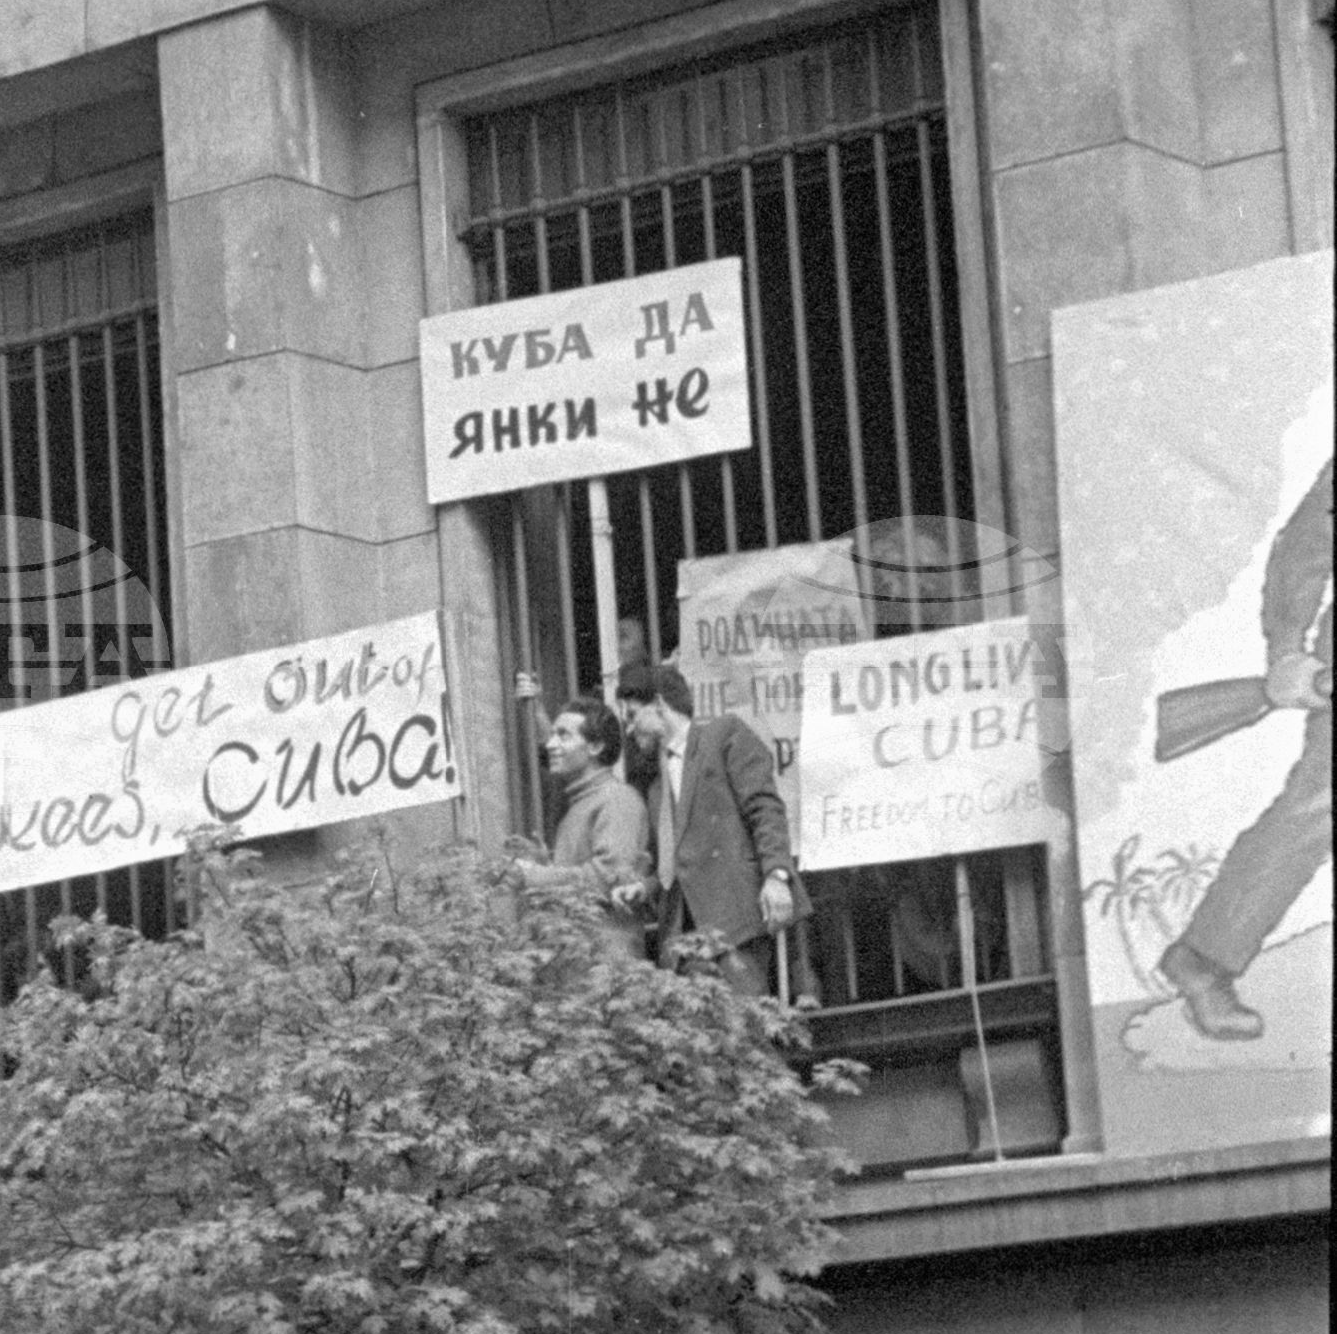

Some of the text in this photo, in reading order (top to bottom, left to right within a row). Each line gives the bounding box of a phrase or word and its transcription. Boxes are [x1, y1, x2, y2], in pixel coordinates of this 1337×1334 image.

[450, 291, 715, 379] КУБА ДА
[448, 397, 598, 459] ЯНКИ
[112, 673, 235, 785] get
[392, 642, 437, 709] of
[830, 651, 951, 717] LONG
